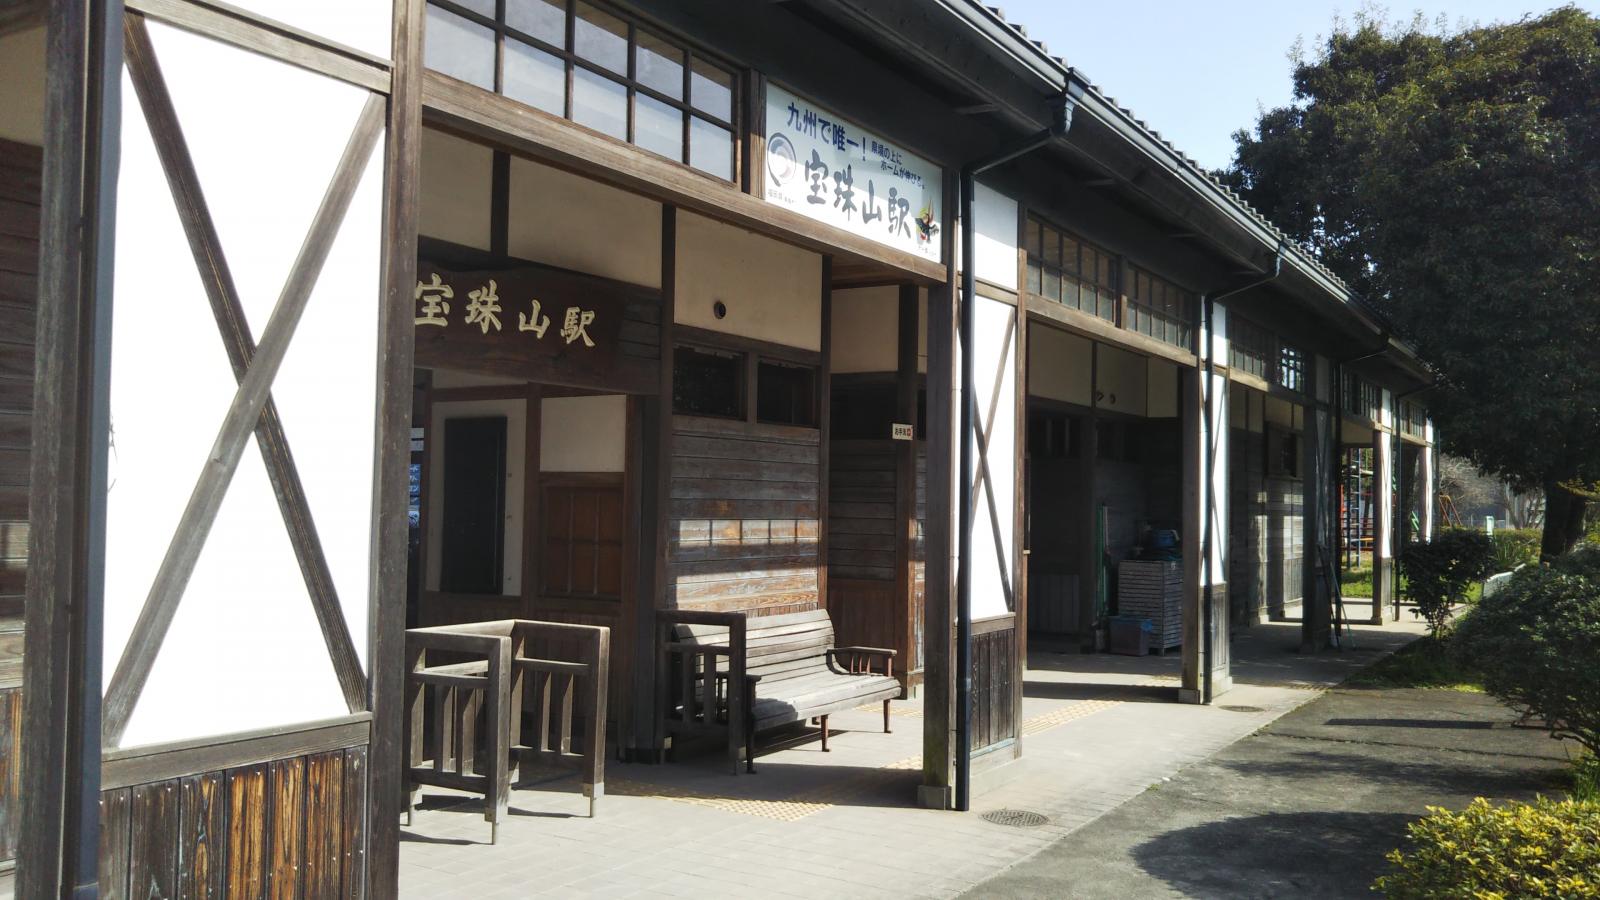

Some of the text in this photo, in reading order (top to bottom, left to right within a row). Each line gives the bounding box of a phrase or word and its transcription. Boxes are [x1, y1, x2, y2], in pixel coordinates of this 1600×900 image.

[804, 148, 912, 239] 宝珠山駅
[415, 272, 596, 347] 宝珠山駅
